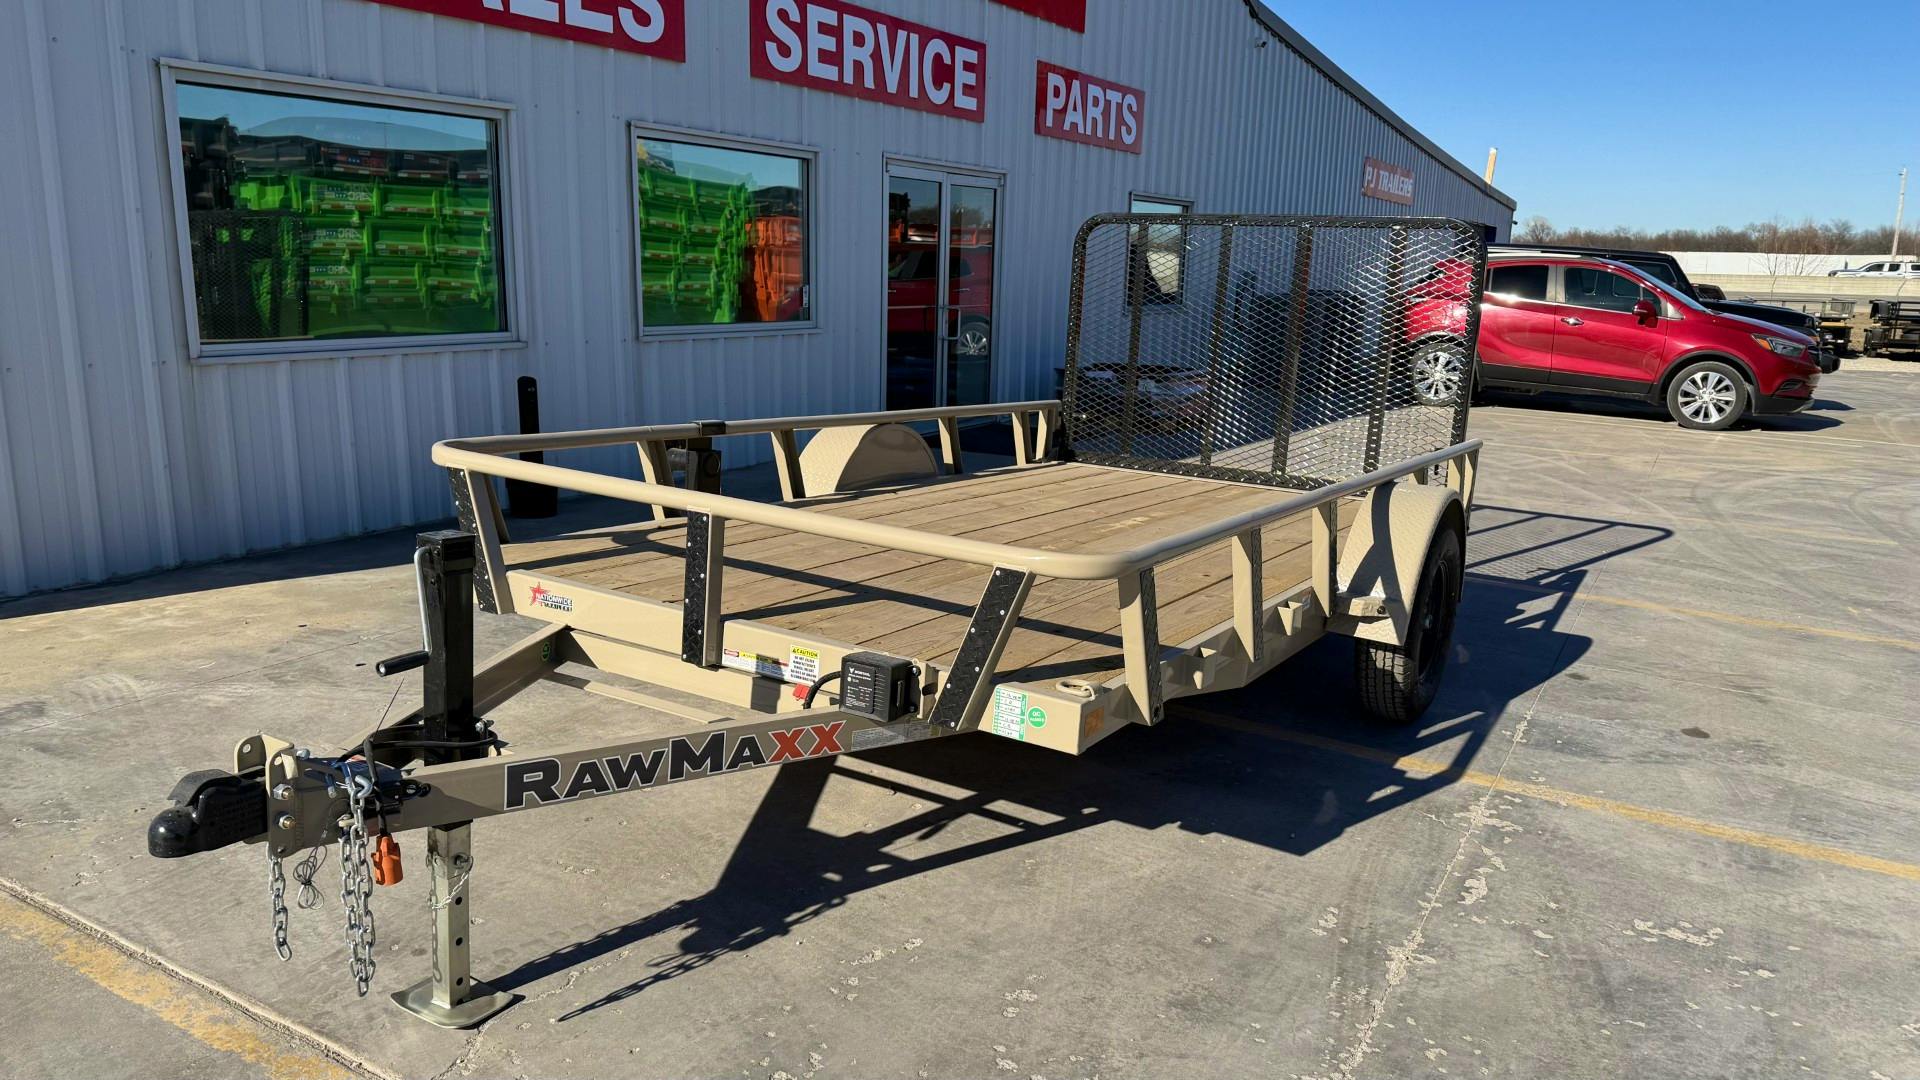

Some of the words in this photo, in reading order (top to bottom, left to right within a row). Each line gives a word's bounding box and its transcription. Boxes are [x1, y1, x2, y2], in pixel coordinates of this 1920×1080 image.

[765, 0, 978, 111] SERVICE
[1045, 71, 1138, 145] PARTS
[796, 648, 818, 657] CAUTION
